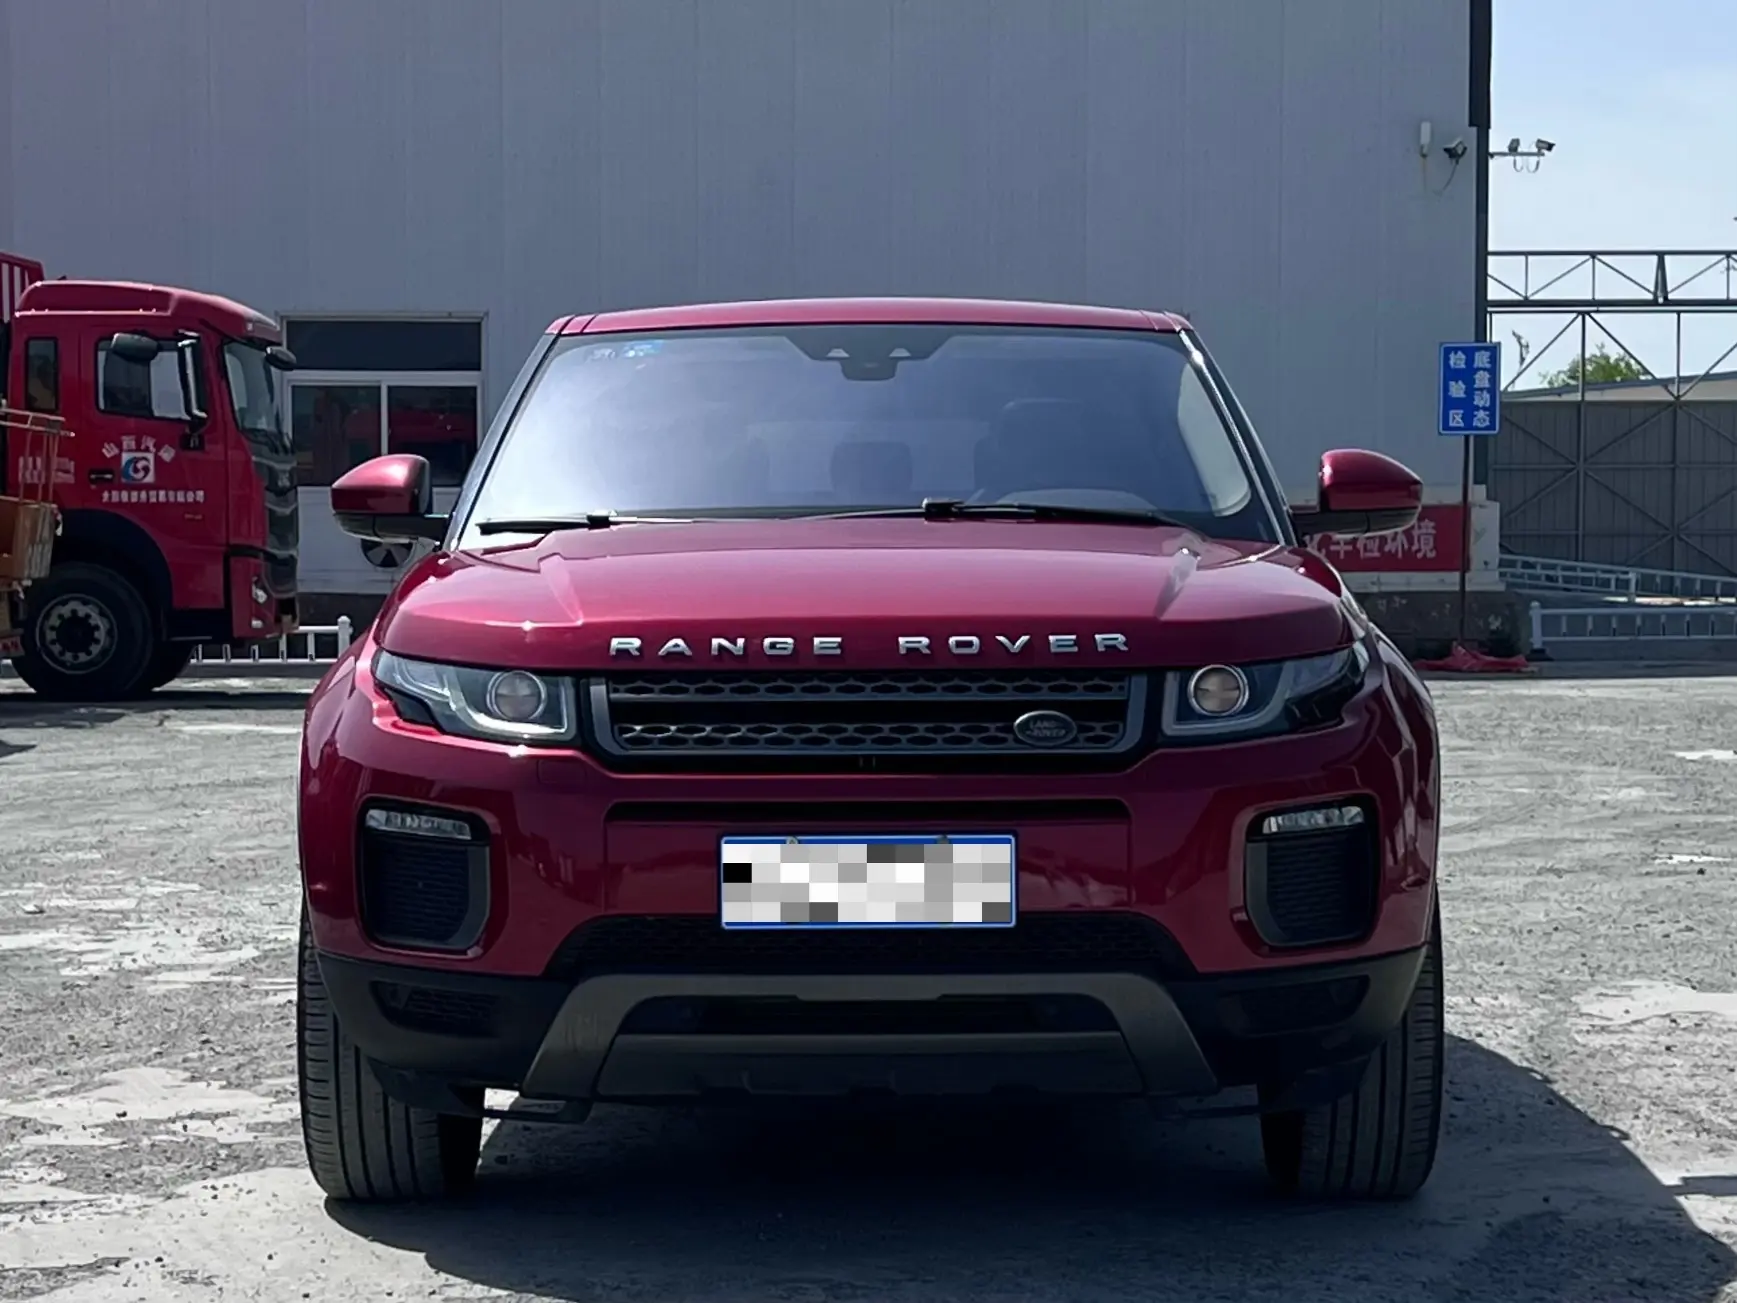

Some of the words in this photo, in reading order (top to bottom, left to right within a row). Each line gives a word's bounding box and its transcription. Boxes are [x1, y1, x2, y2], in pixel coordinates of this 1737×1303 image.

[1448, 350, 1467, 427] 检验区
[608, 636, 843, 657] RANGE
[898, 633, 1129, 655] ROVER
